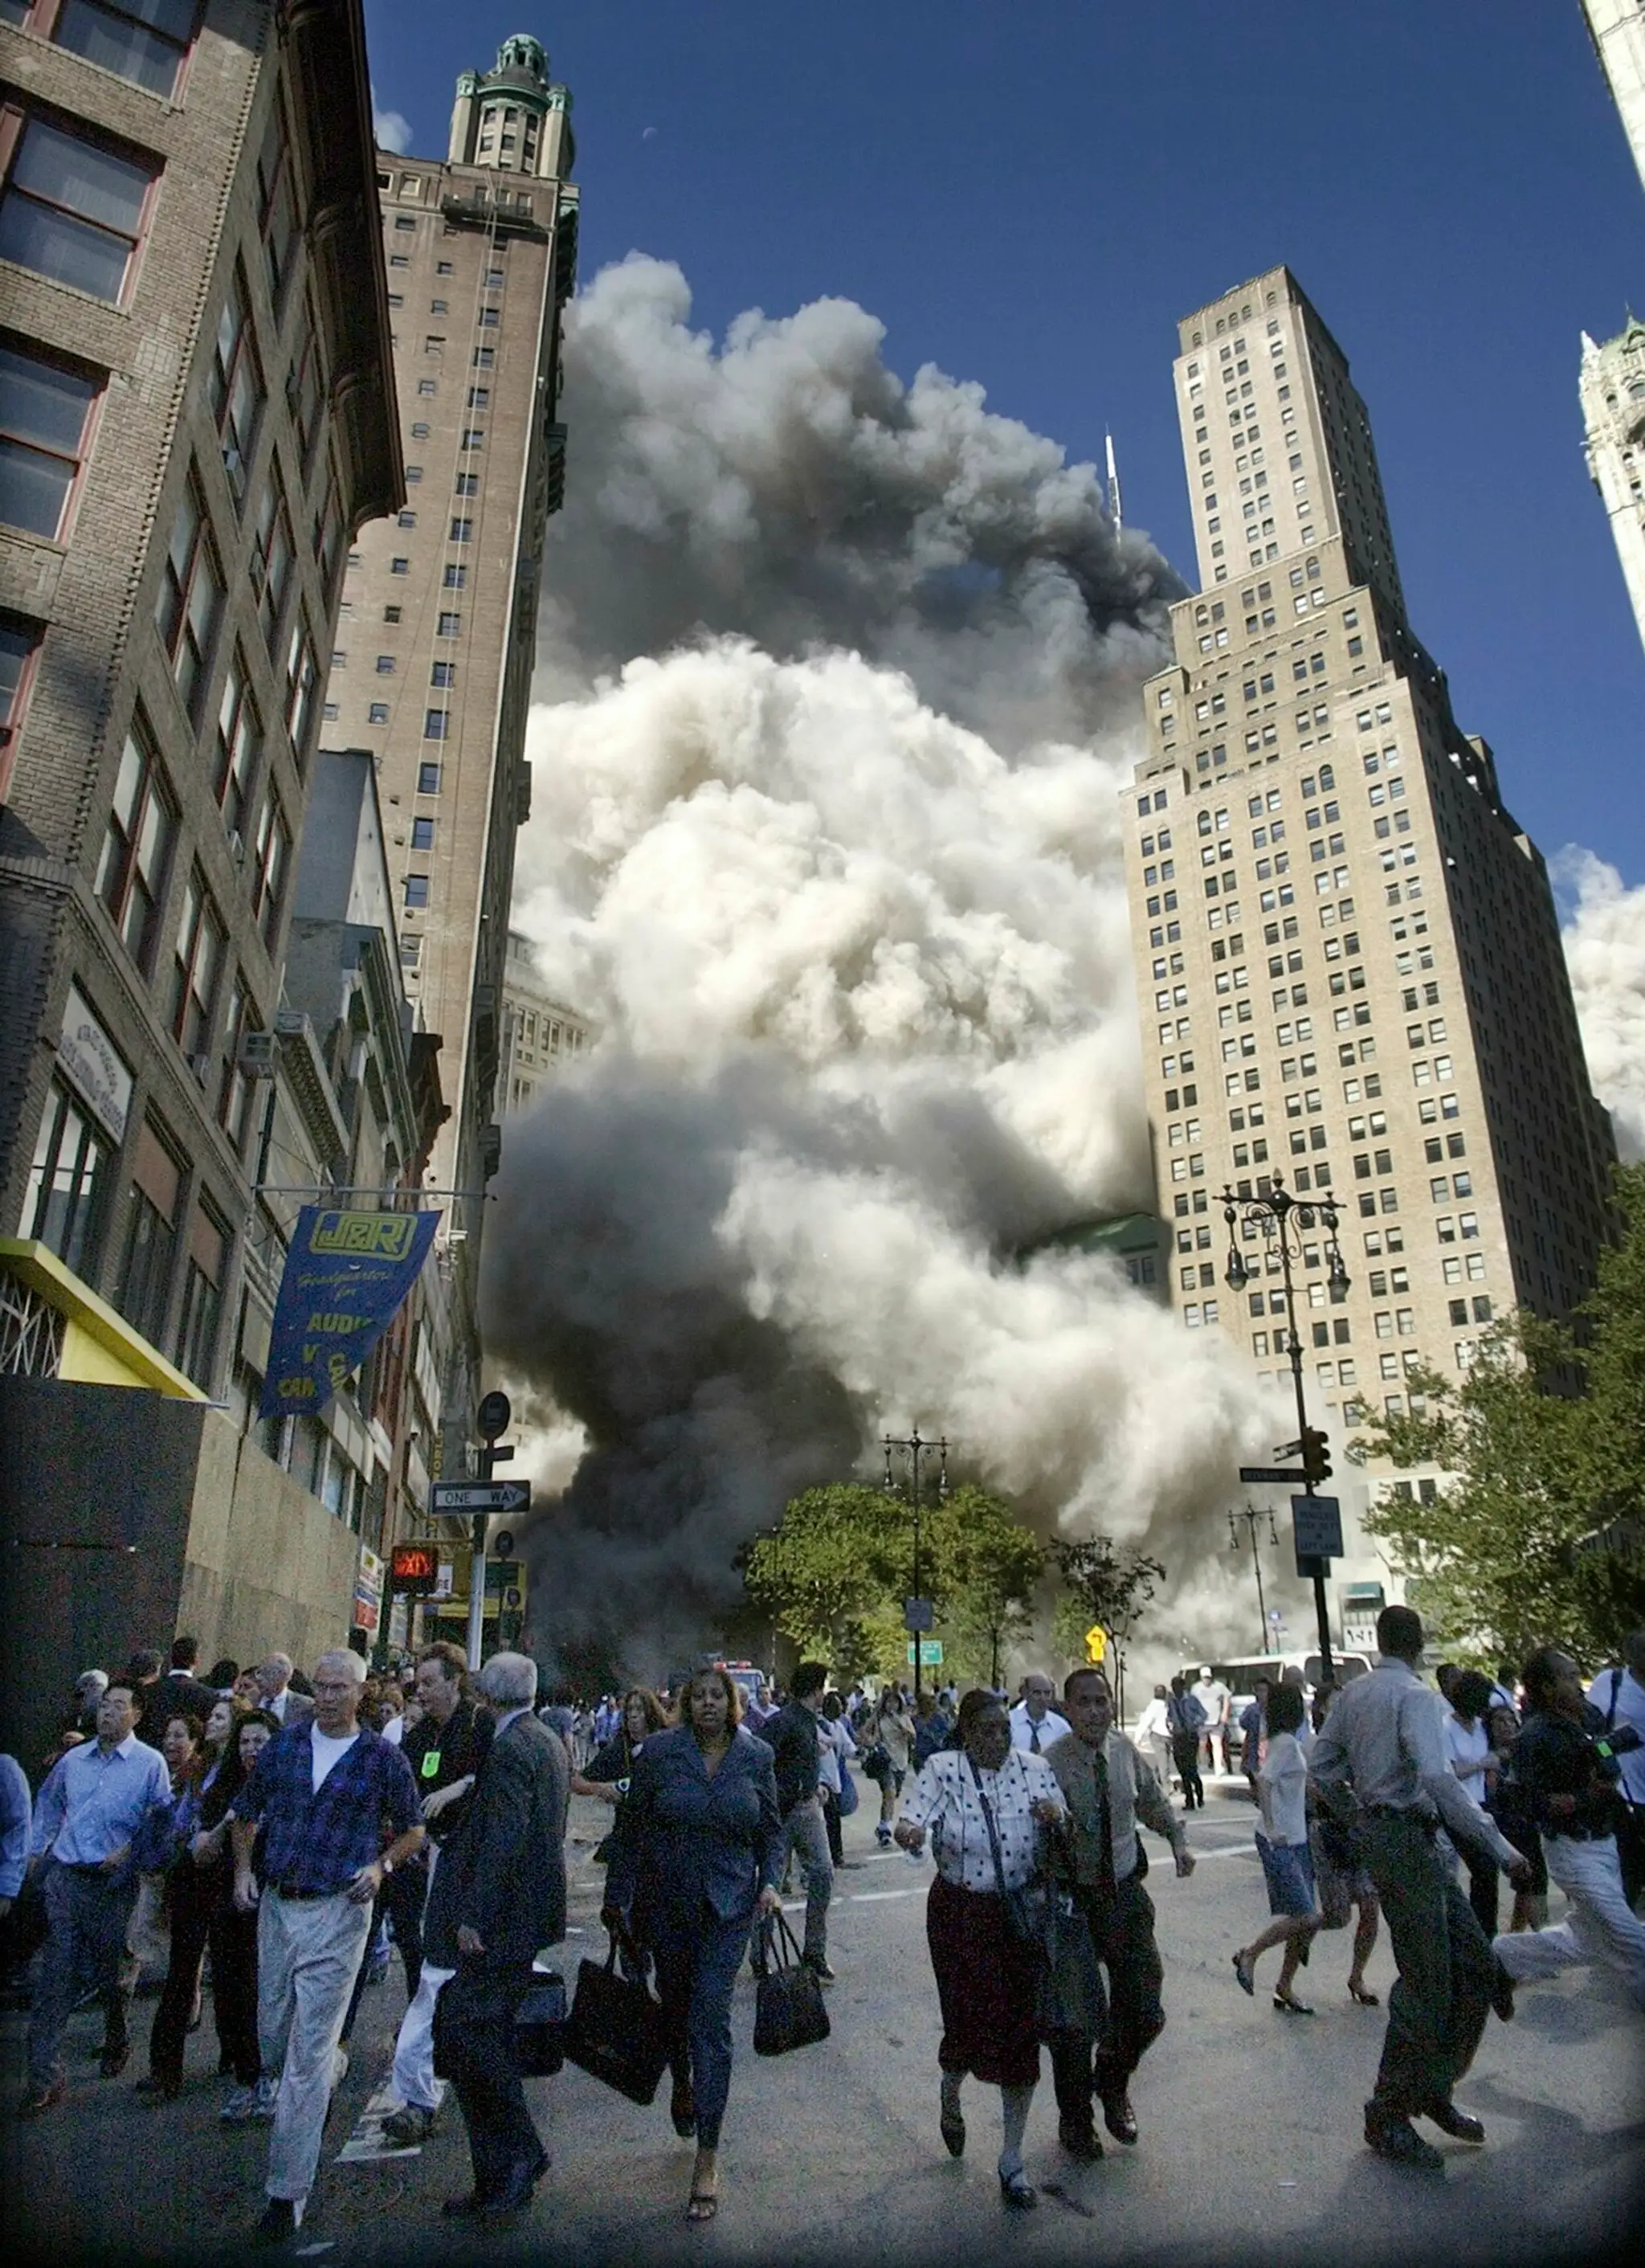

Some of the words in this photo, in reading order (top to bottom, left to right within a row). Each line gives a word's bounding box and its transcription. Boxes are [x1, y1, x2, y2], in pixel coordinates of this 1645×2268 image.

[315, 1216, 404, 1253] J&R
[445, 1492, 472, 1505] ONE
[490, 1490, 518, 1502] WAY
